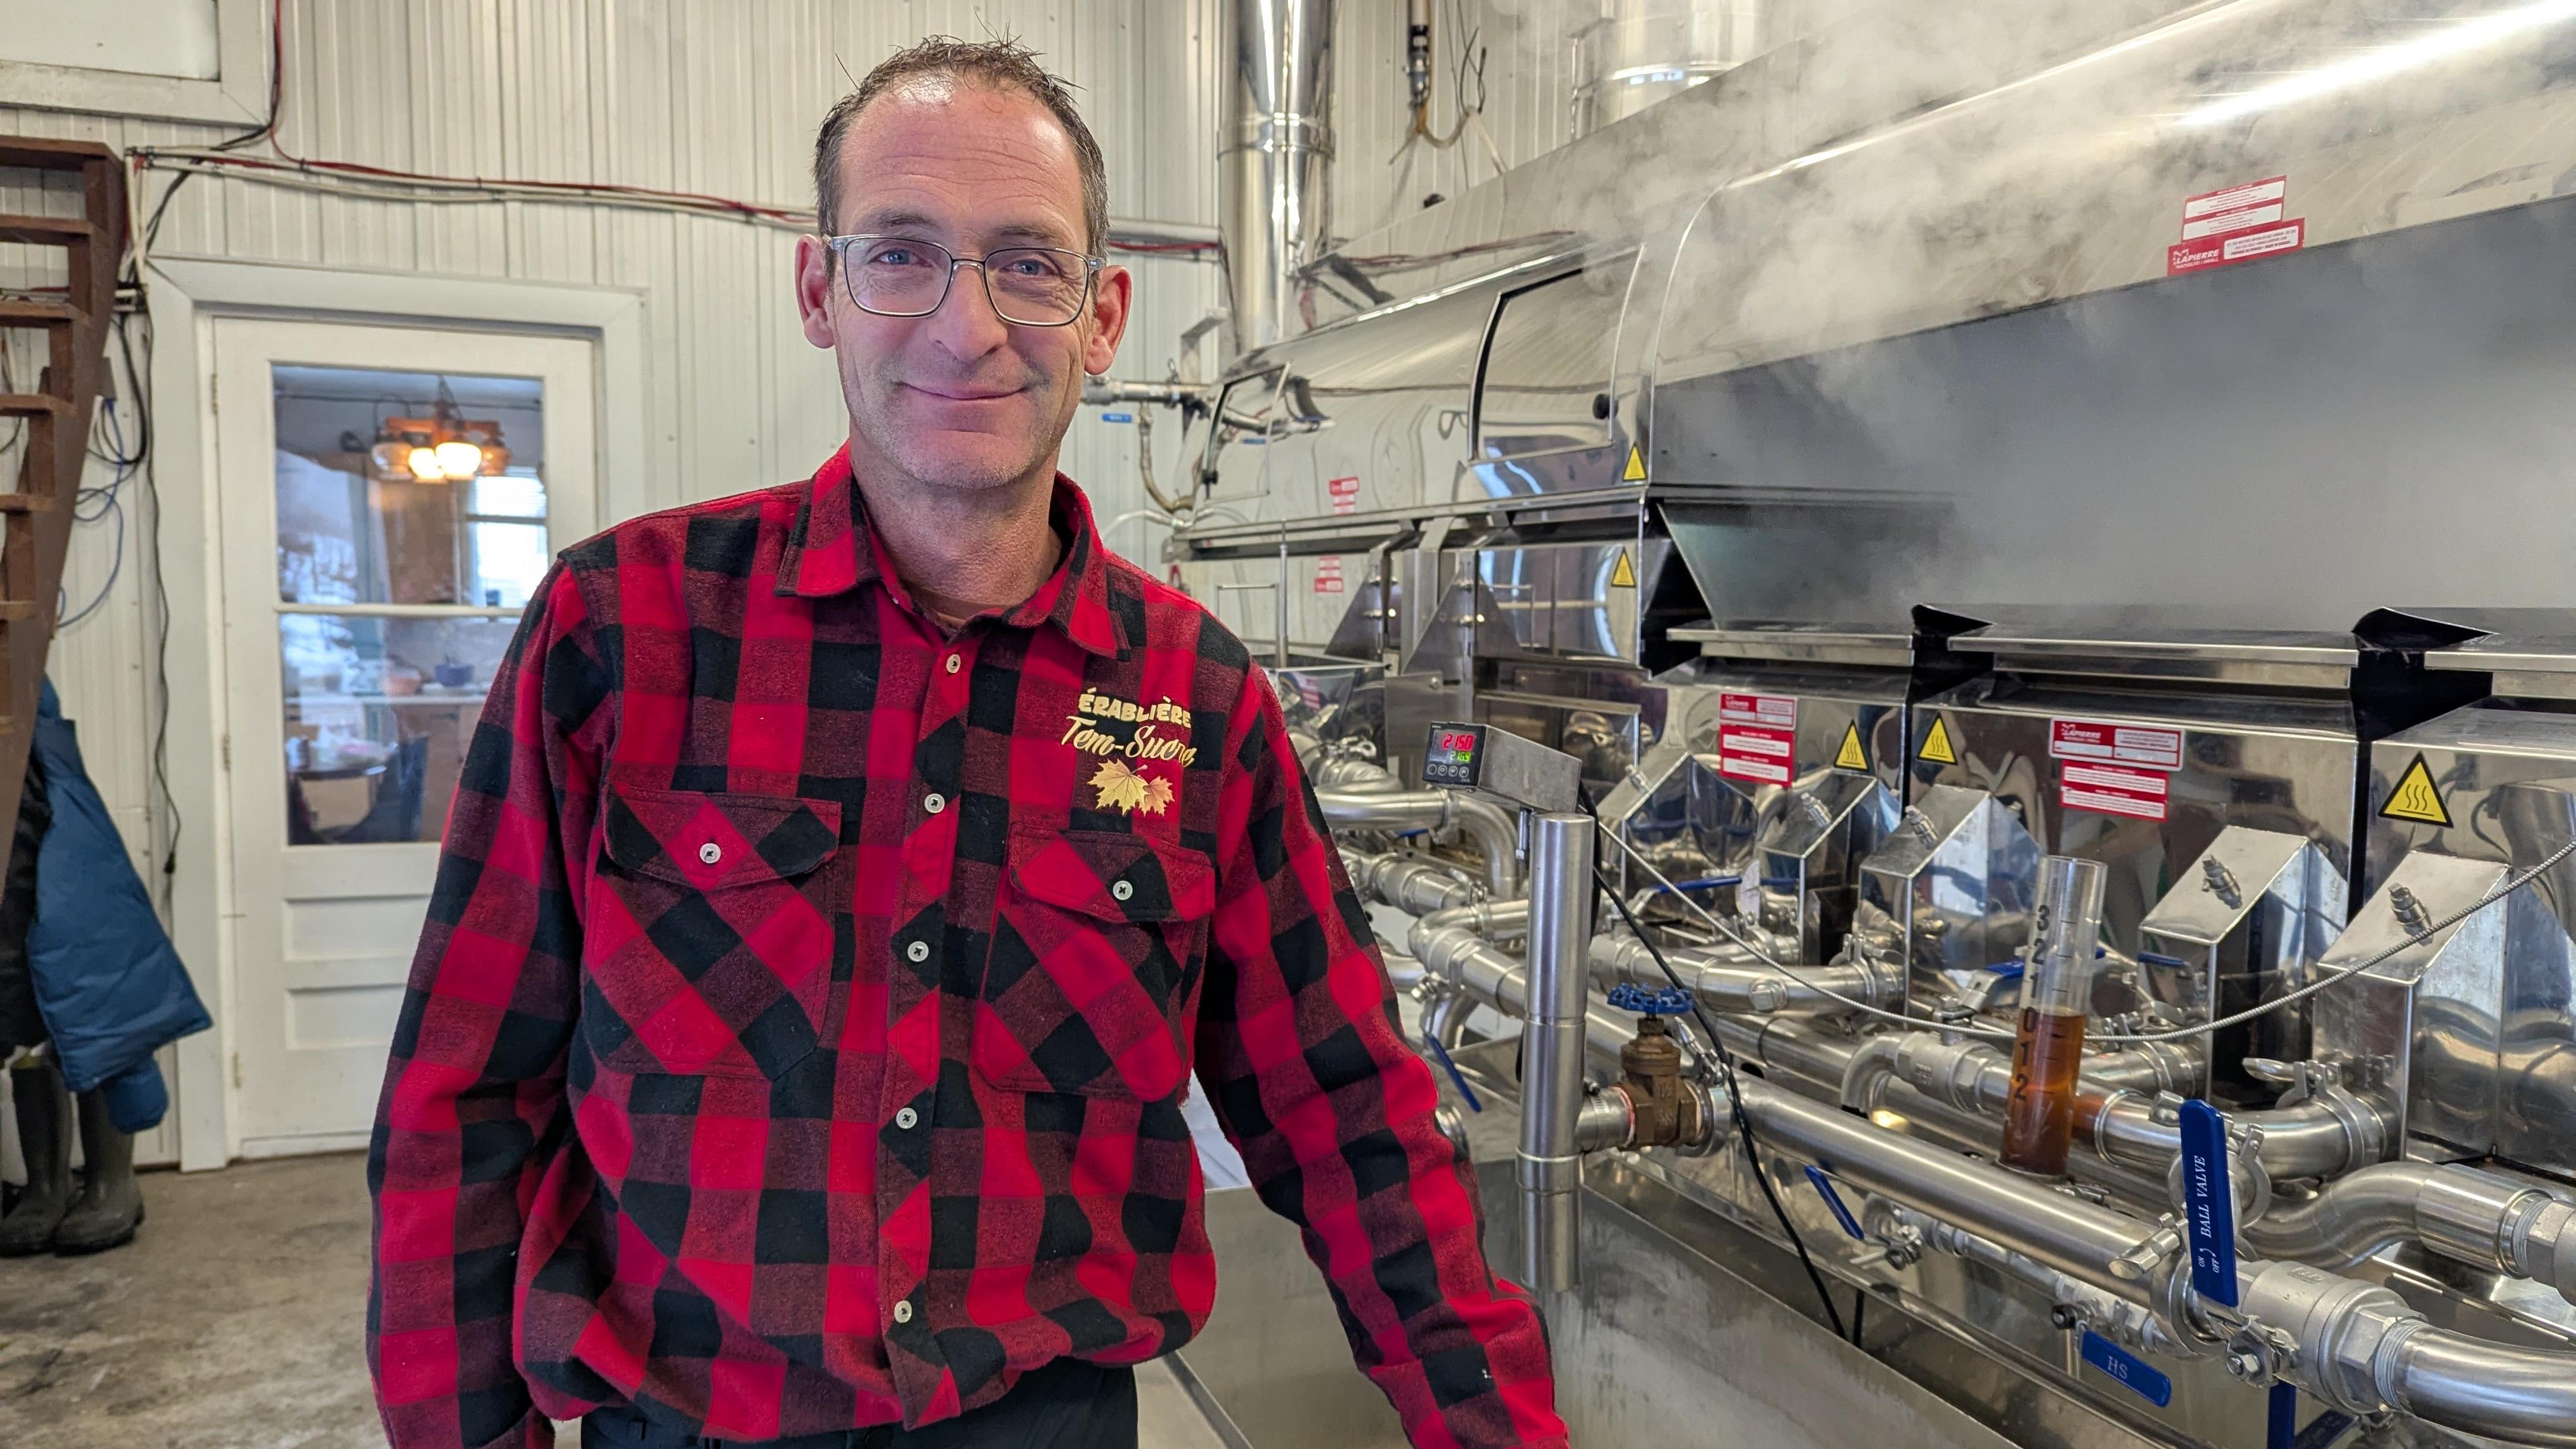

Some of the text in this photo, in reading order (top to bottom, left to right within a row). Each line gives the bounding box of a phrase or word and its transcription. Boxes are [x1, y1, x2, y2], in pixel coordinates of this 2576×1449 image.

[1078, 687, 1192, 729] ÉRABLIÈRE
[1061, 715, 1197, 768] Tem-Sucre
[2036, 904, 2051, 931] 3
[2031, 938, 2046, 965] 2
[2030, 972, 2039, 998] 1
[2024, 1006, 2037, 1033] 0
[2021, 1041, 2030, 1066] 1
[2014, 1073, 2029, 1100] 2
[2193, 1155, 2212, 1238] BALL VALVE
[2198, 1256, 2205, 1267] ON
[2212, 1257, 2220, 1273] OFF
[2107, 1355, 2128, 1380] HS
